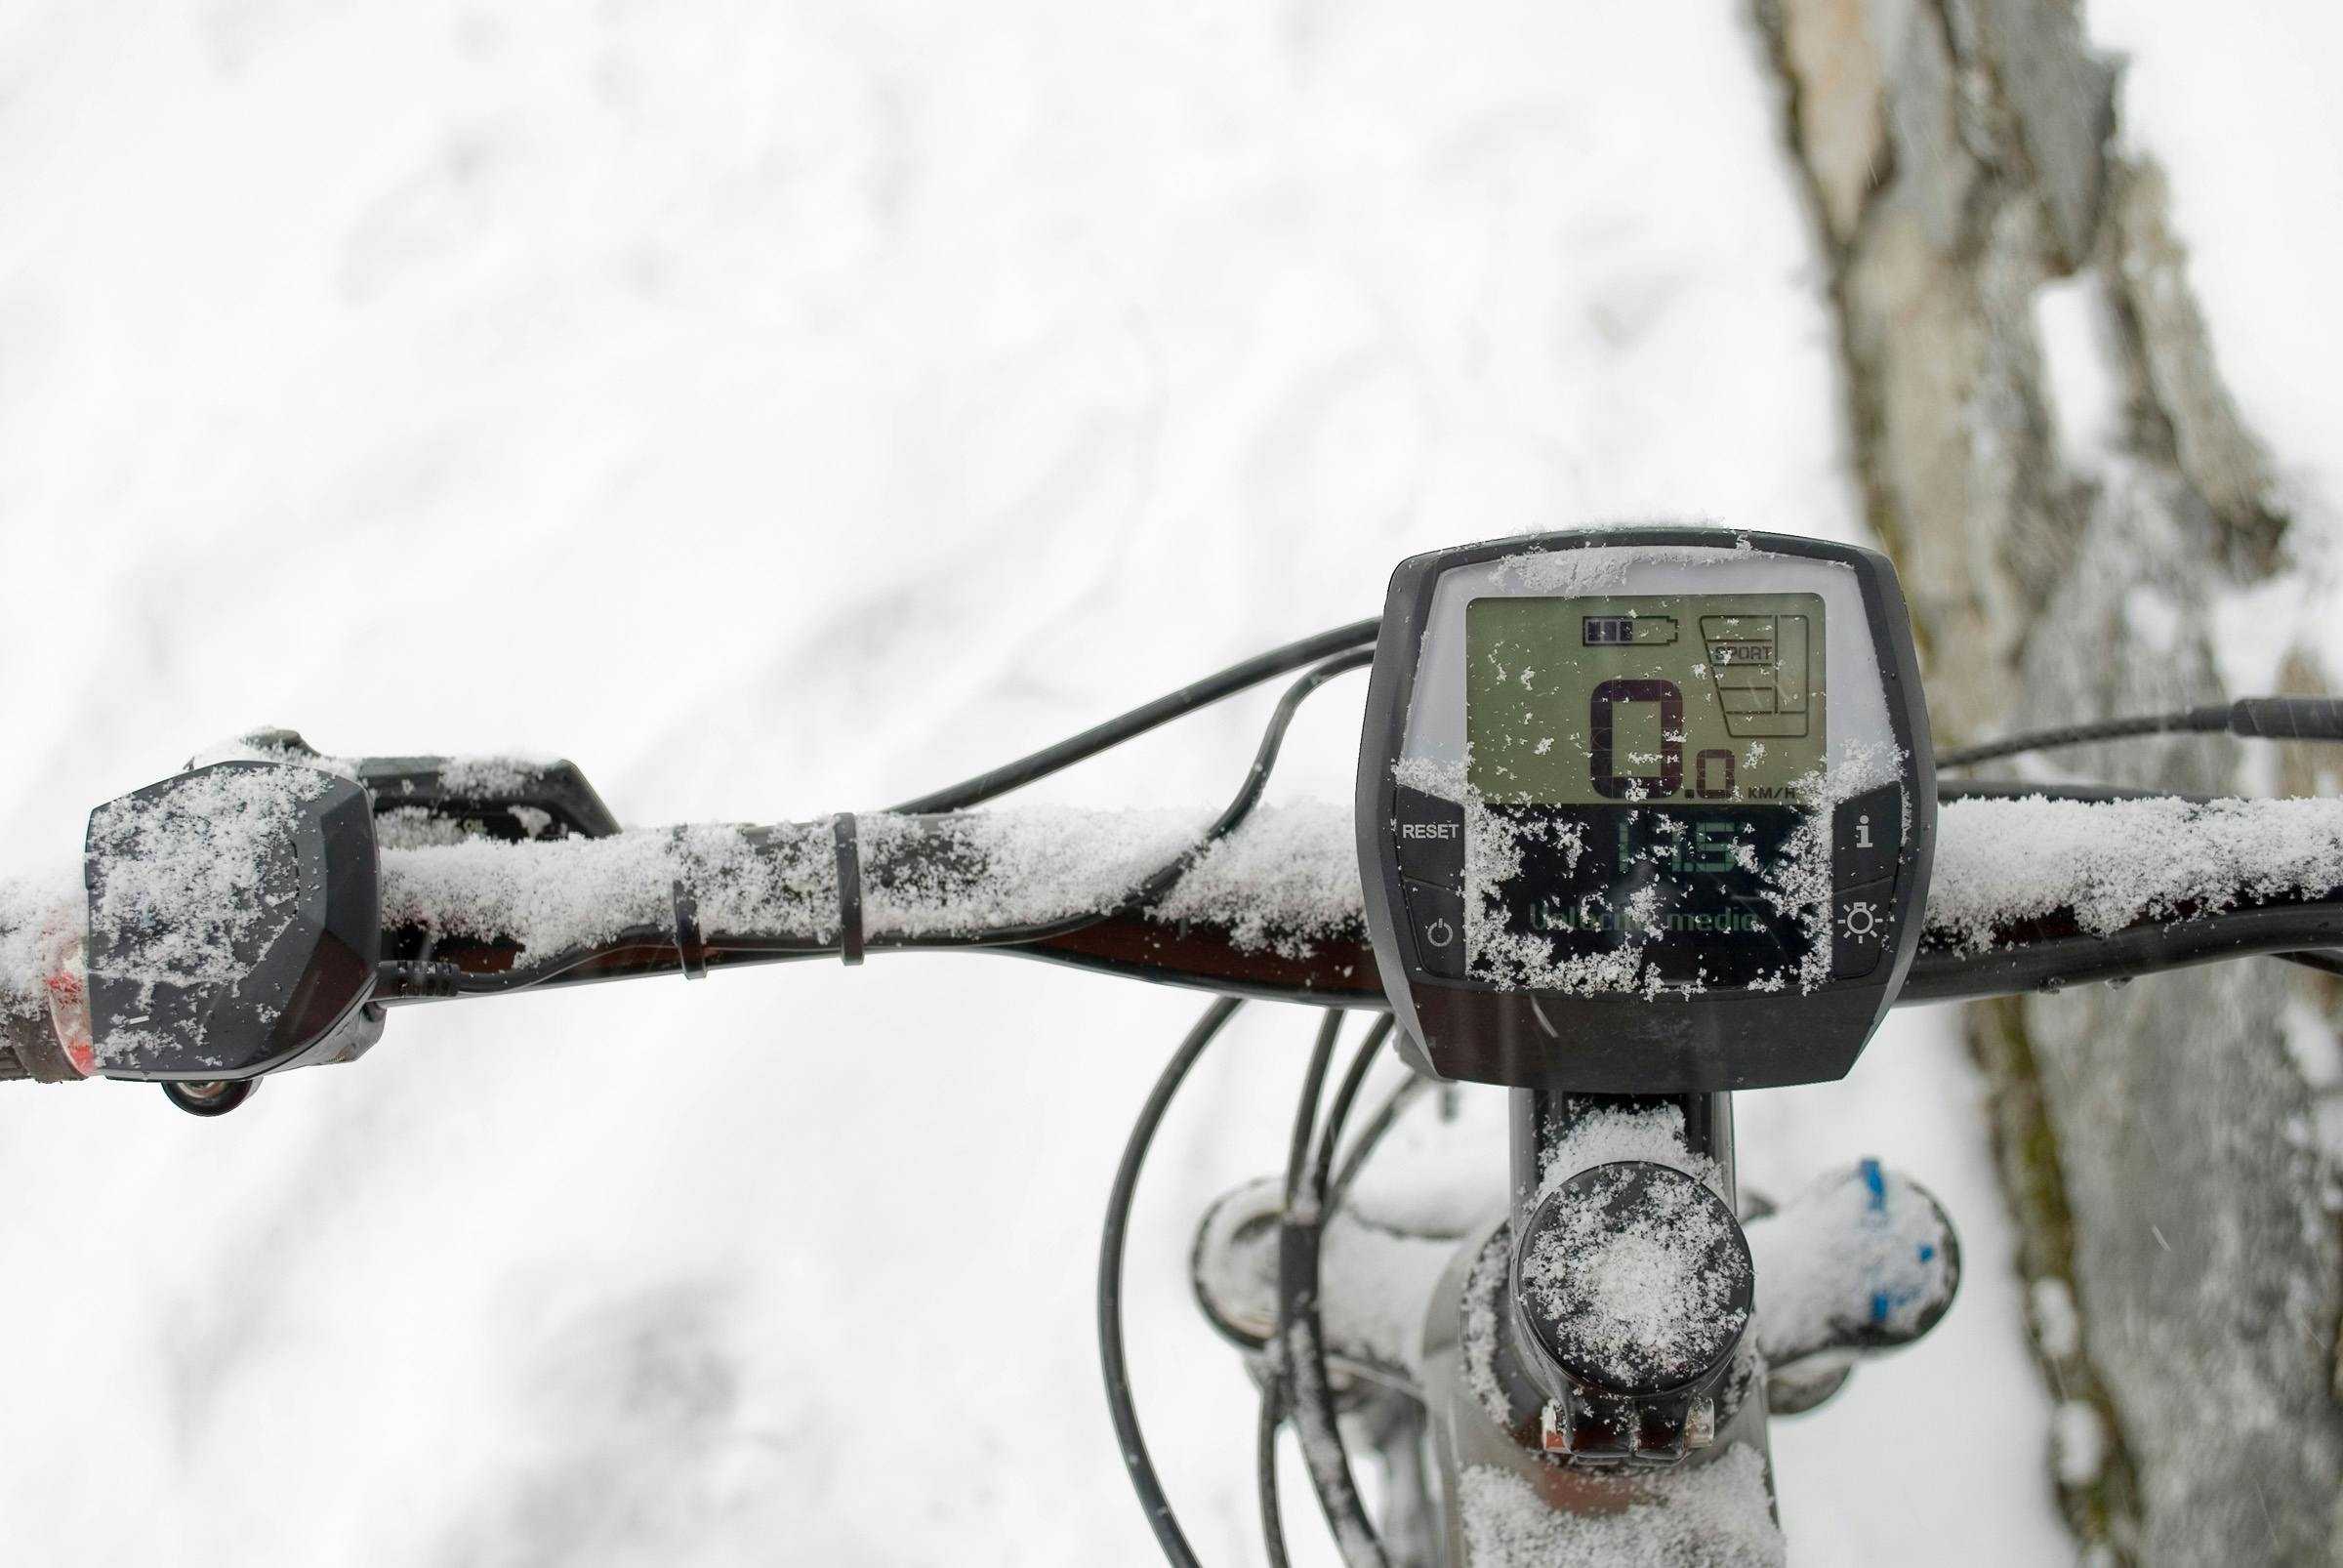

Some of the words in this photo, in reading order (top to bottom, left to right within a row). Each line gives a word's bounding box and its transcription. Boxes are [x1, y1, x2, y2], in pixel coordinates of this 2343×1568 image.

[1715, 646, 1772, 660] SPORT
[1590, 680, 1735, 799] 0.0
[1748, 787, 1795, 800] KM/H
[1403, 824, 1459, 839] RESET
[1856, 815, 1873, 848] i
